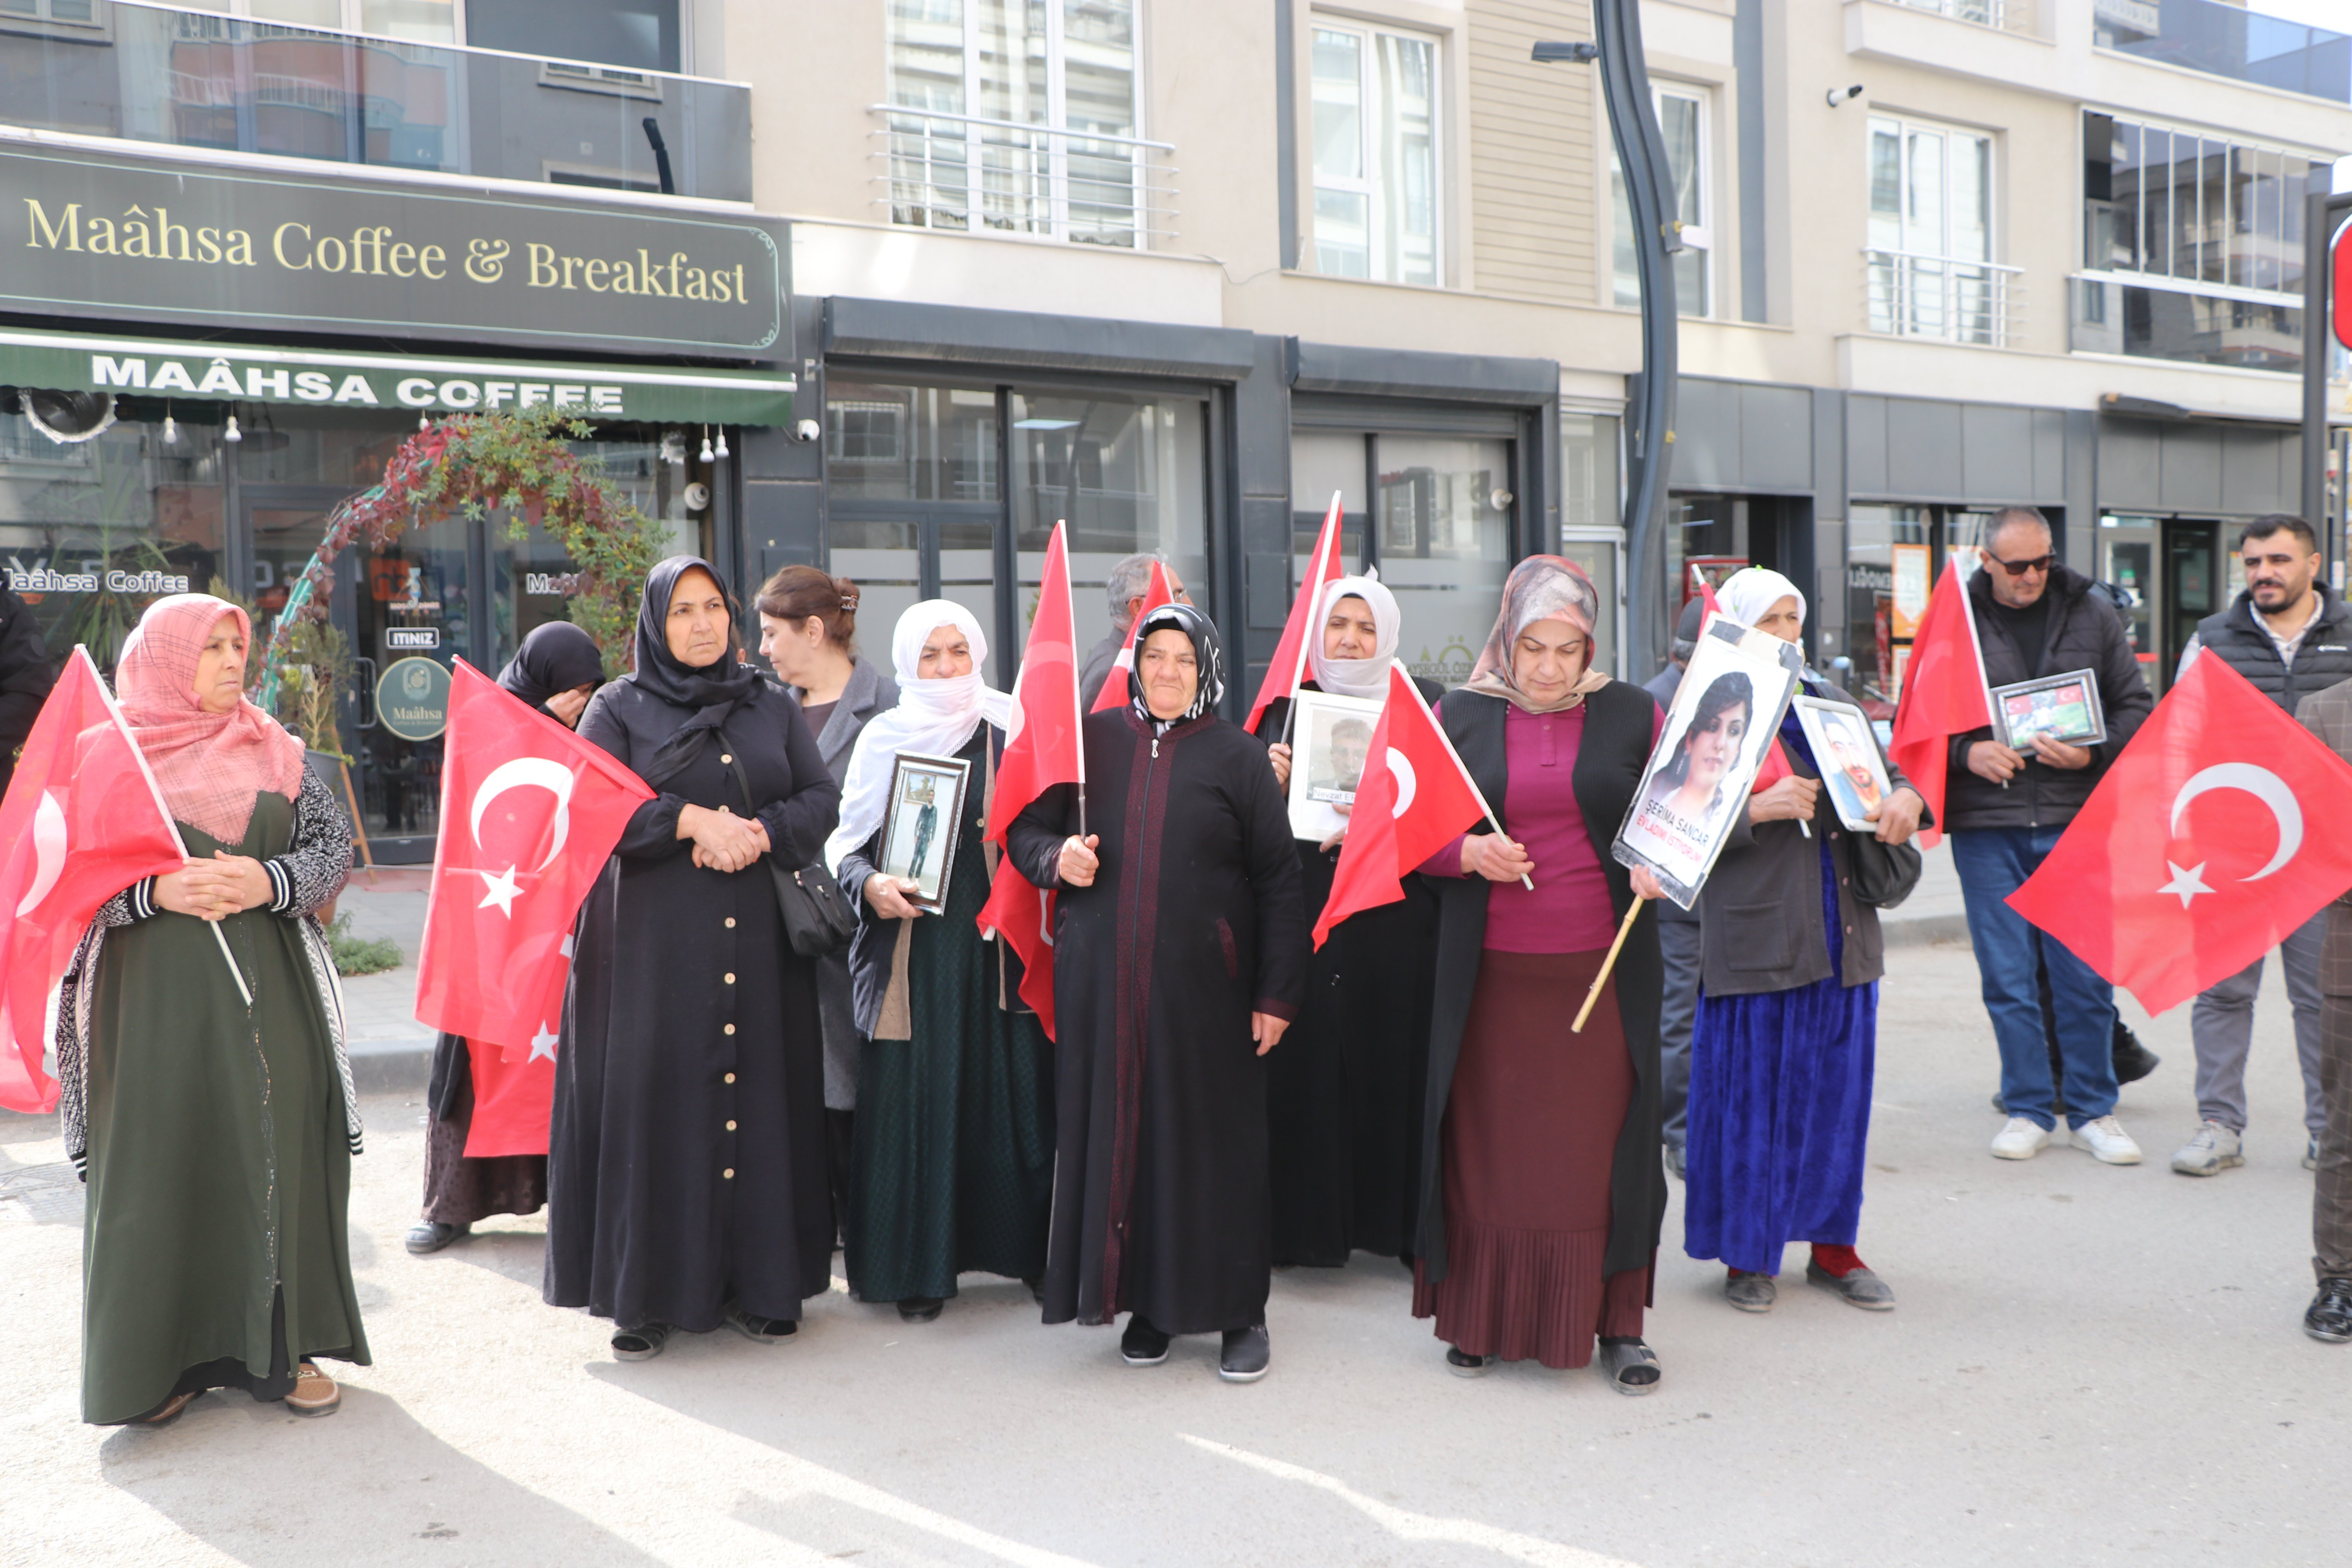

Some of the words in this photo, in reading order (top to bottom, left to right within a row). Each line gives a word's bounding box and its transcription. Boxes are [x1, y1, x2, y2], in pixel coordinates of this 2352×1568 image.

[24, 198, 257, 267] Maâhsa
[272, 222, 447, 280] Coffee
[464, 238, 511, 283] &
[526, 243, 749, 305] Breakfast
[92, 356, 379, 404] MAÂHSA
[397, 378, 624, 414] COFFEE
[107, 570, 189, 592] Coffee
[393, 706, 443, 719] Maâhsa
[1314, 789, 1342, 800] Nevzat
[1676, 818, 1709, 848] SANCAR
